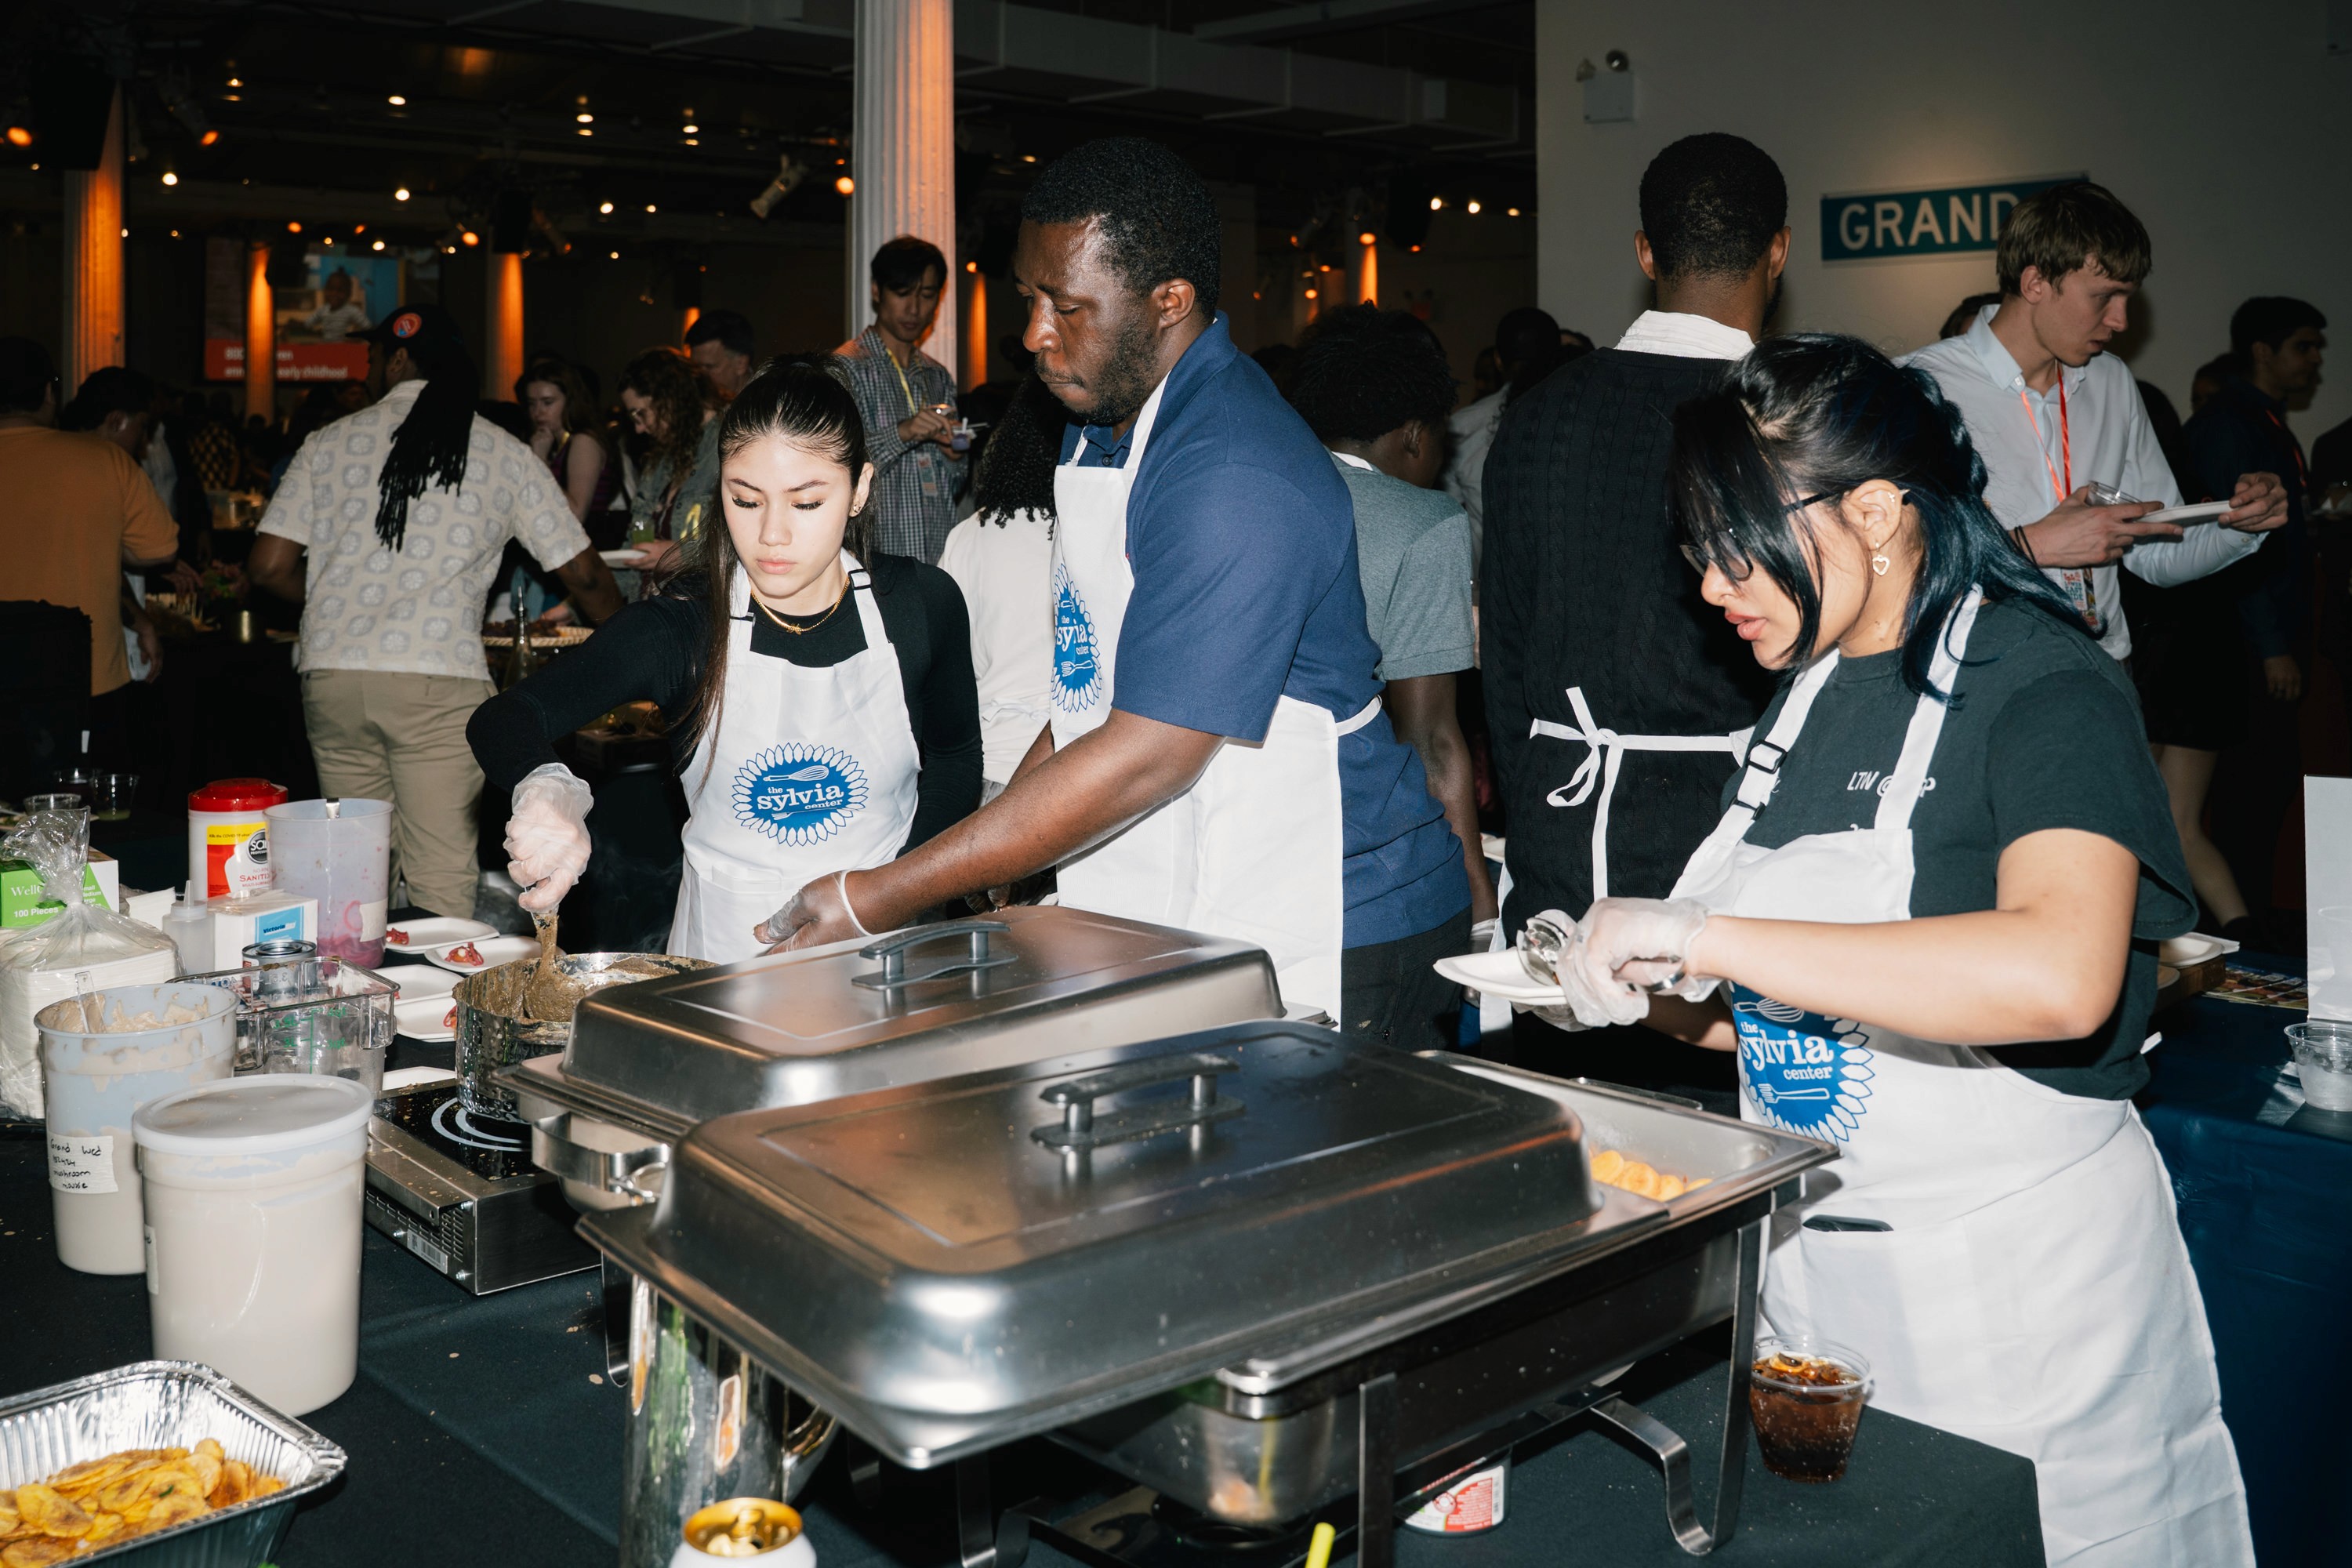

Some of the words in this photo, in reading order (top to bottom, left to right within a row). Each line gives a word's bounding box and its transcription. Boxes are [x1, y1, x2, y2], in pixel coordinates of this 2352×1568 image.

[1839, 191, 2020, 251] GRAND
[757, 783, 844, 811] sylvia
[804, 799, 843, 810] center
[14, 909, 29, 918] 100
[31, 906, 59, 916] Pieces
[1740, 1022, 1759, 1033] the
[1739, 1029, 1835, 1072] sylvia
[1783, 1065, 1833, 1080] center
[53, 1169, 92, 1178] mushroom
